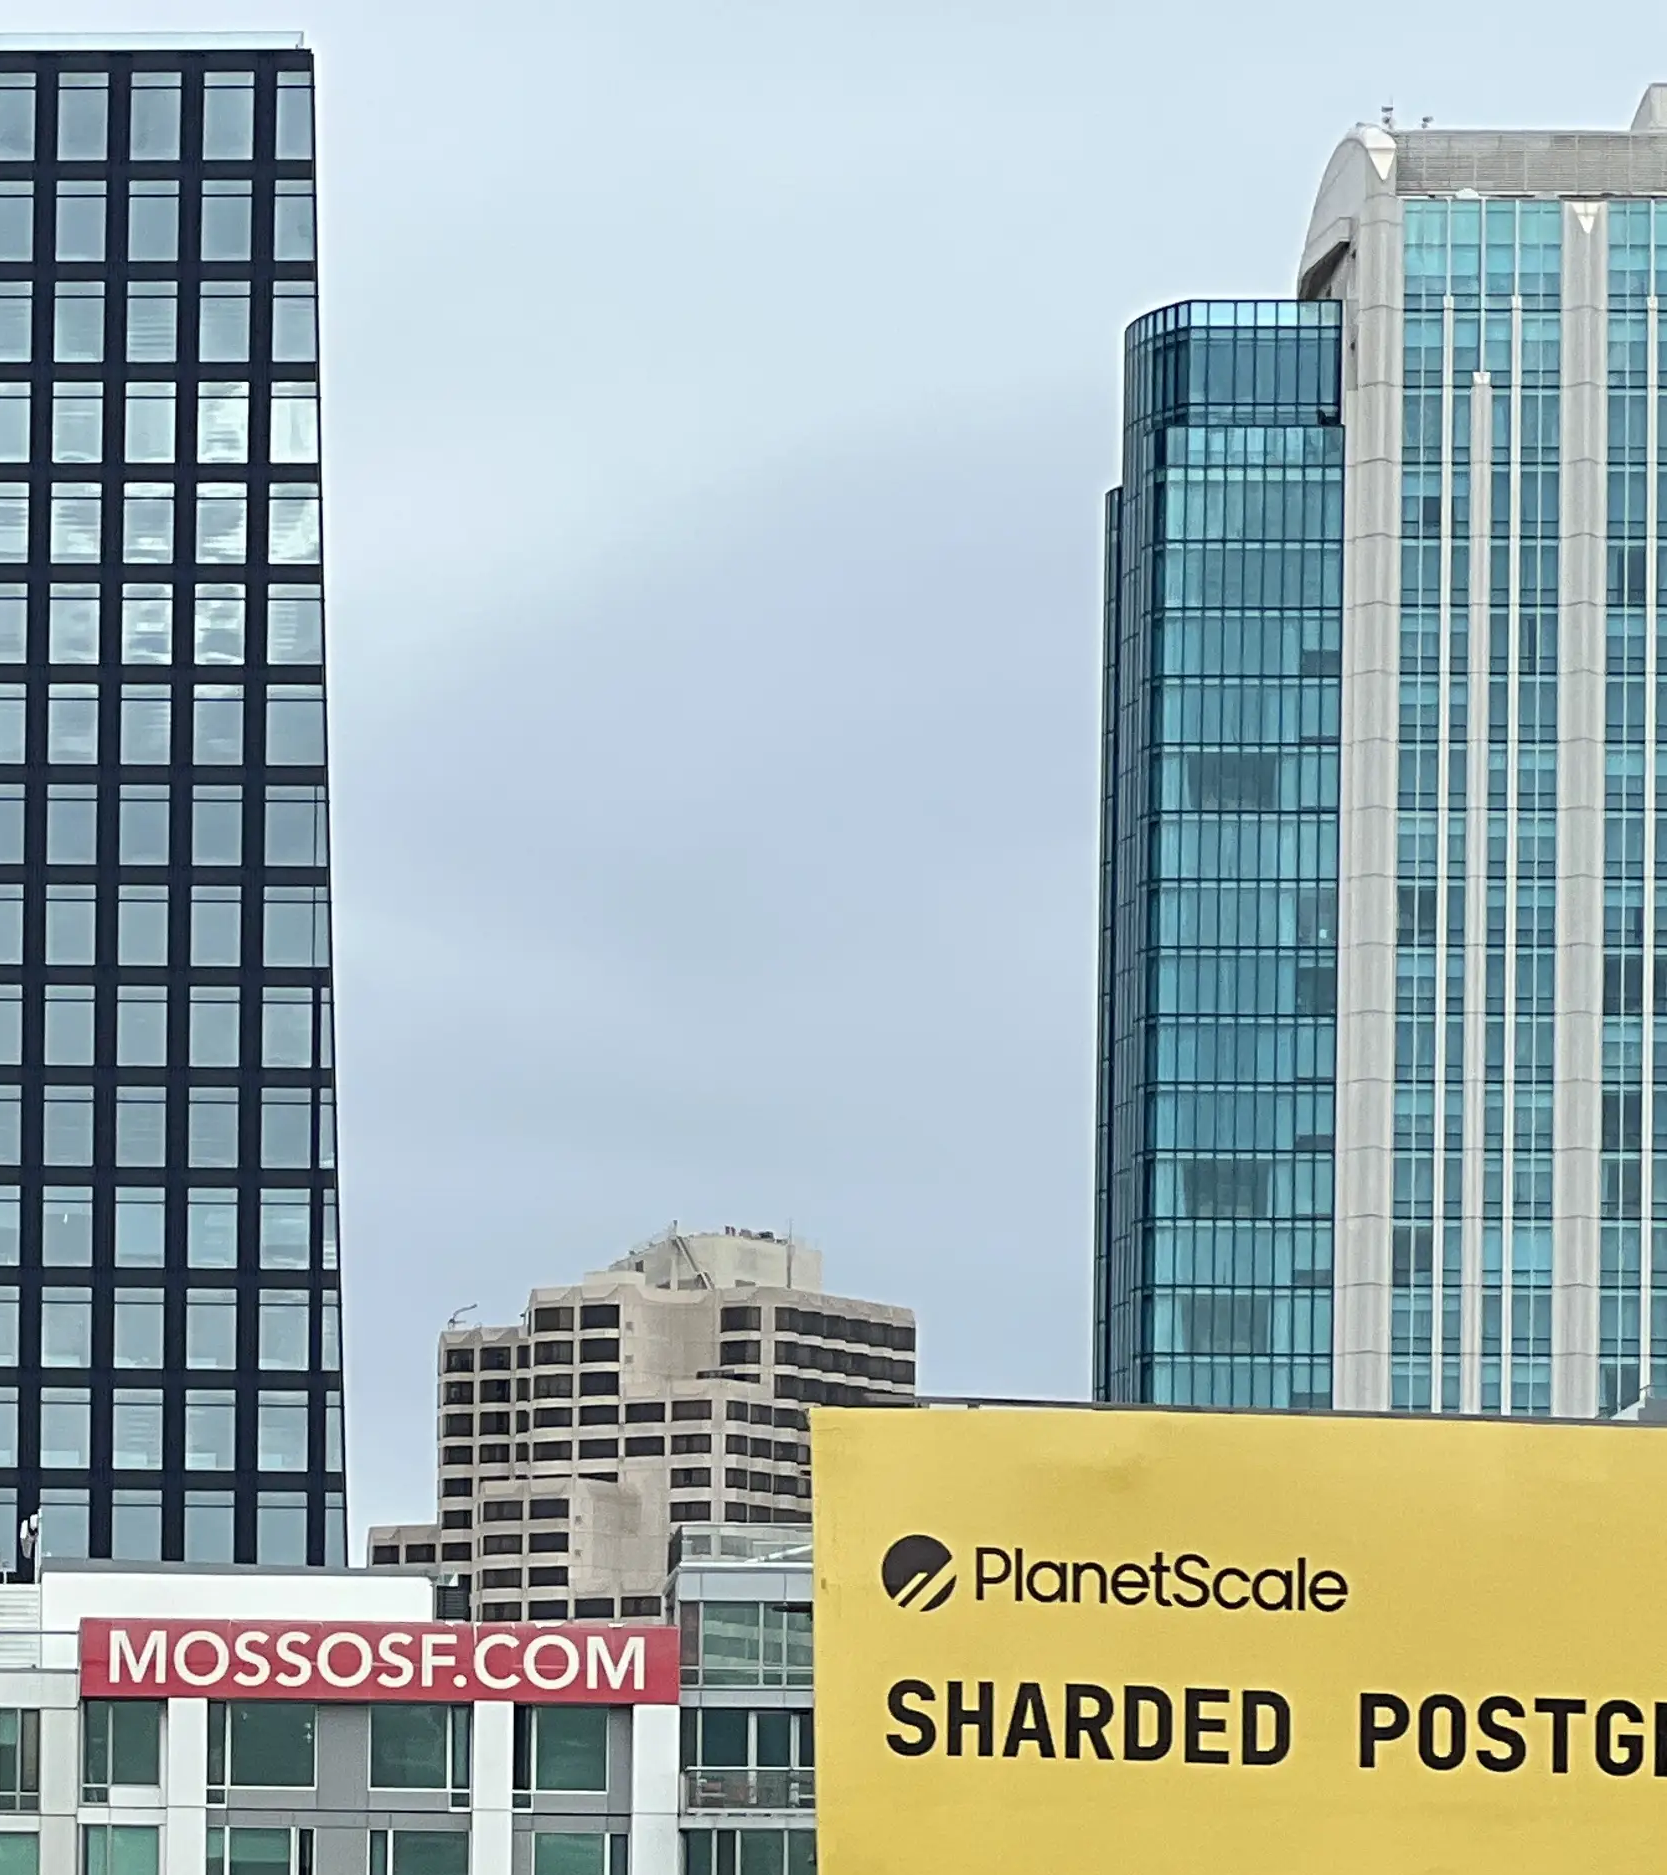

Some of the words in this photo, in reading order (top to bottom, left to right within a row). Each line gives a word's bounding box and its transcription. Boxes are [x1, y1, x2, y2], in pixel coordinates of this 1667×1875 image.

[975, 1546, 1349, 1613] PlanetScale
[108, 1628, 646, 1690] MOSSOSF.COM
[886, 1679, 1291, 1766] SHARDED
[1359, 1692, 1667, 1778] POSTG
